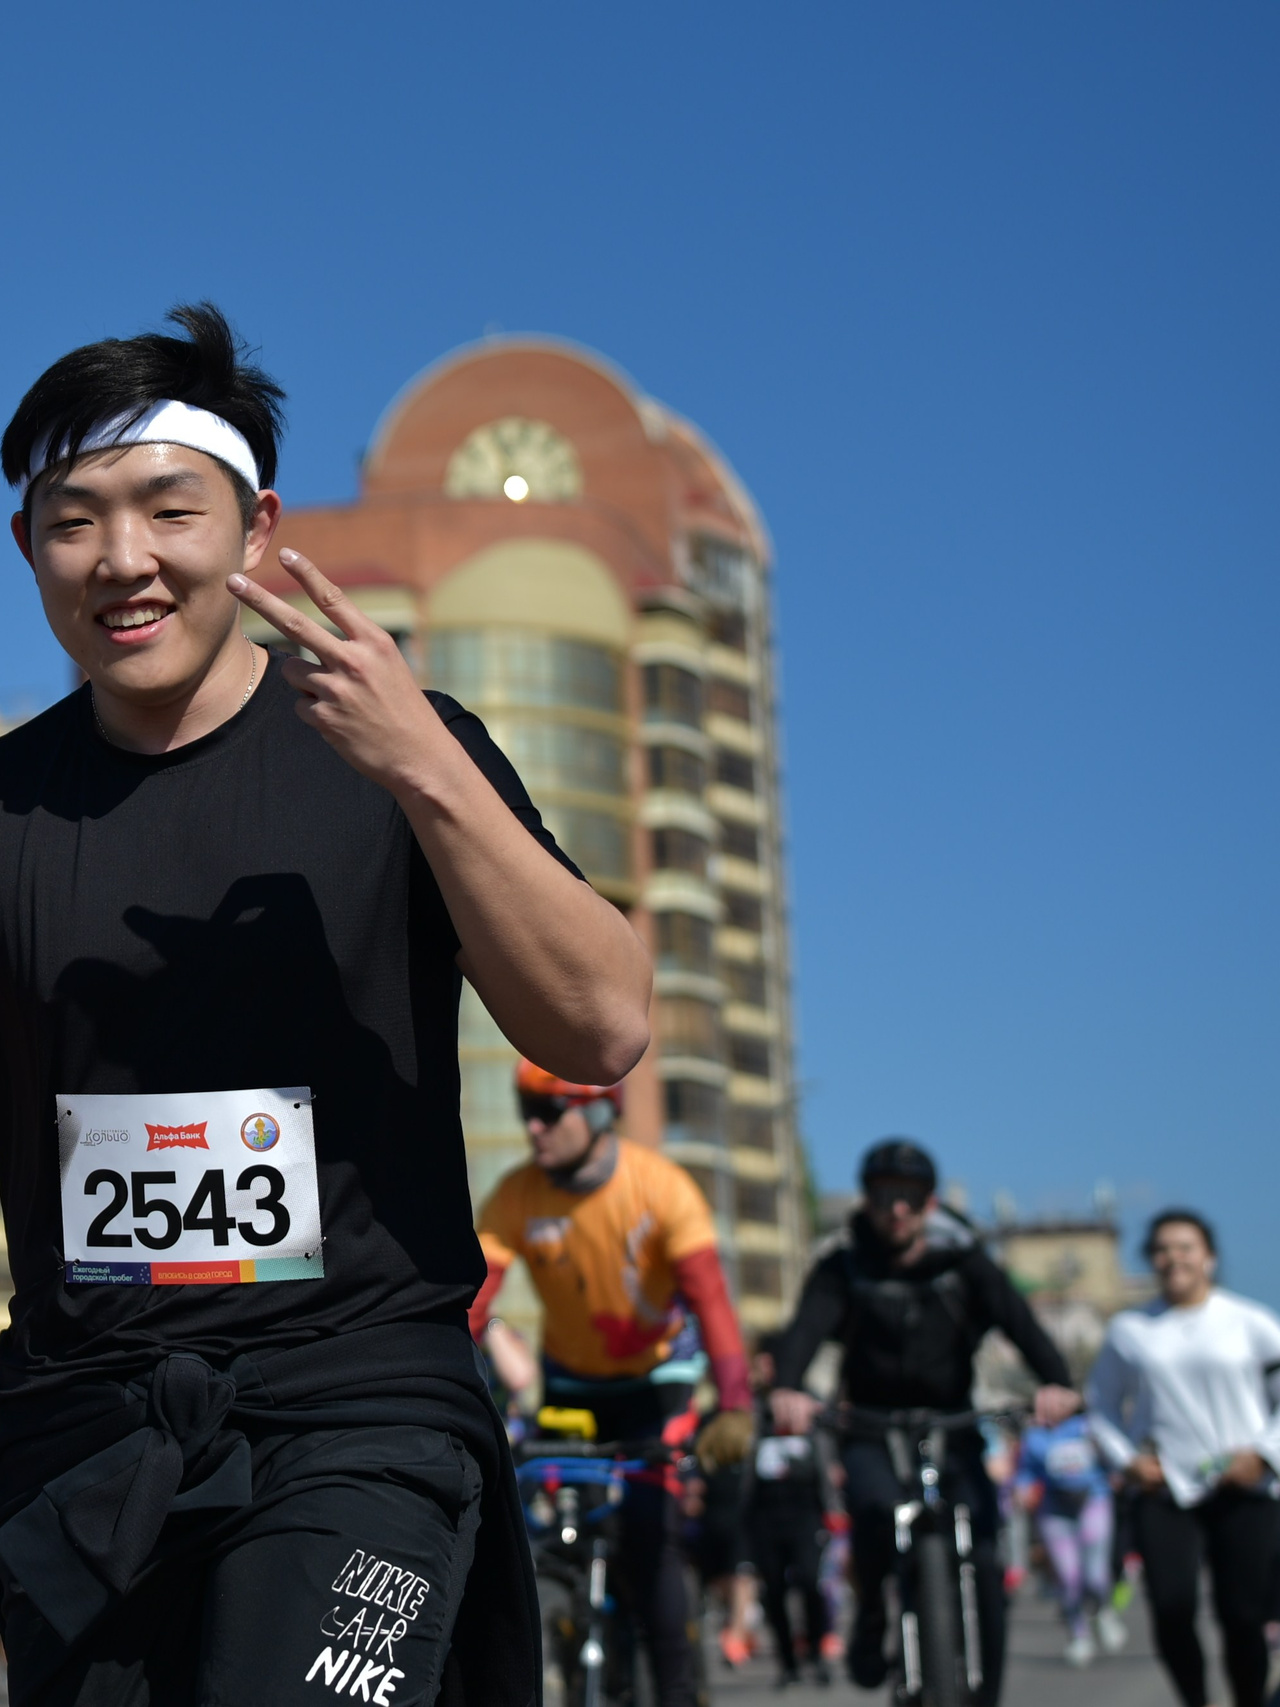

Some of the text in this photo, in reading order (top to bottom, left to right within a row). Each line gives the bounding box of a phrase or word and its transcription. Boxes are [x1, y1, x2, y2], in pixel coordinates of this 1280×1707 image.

[153, 1131, 201, 1144] Альфа Банк
[83, 1164, 291, 1250] 2543
[72, 1273, 134, 1284] городской пробег
[331, 1549, 430, 1621] NIKE
[337, 1606, 408, 1664] AIR
[304, 1646, 406, 1707] NIKE
